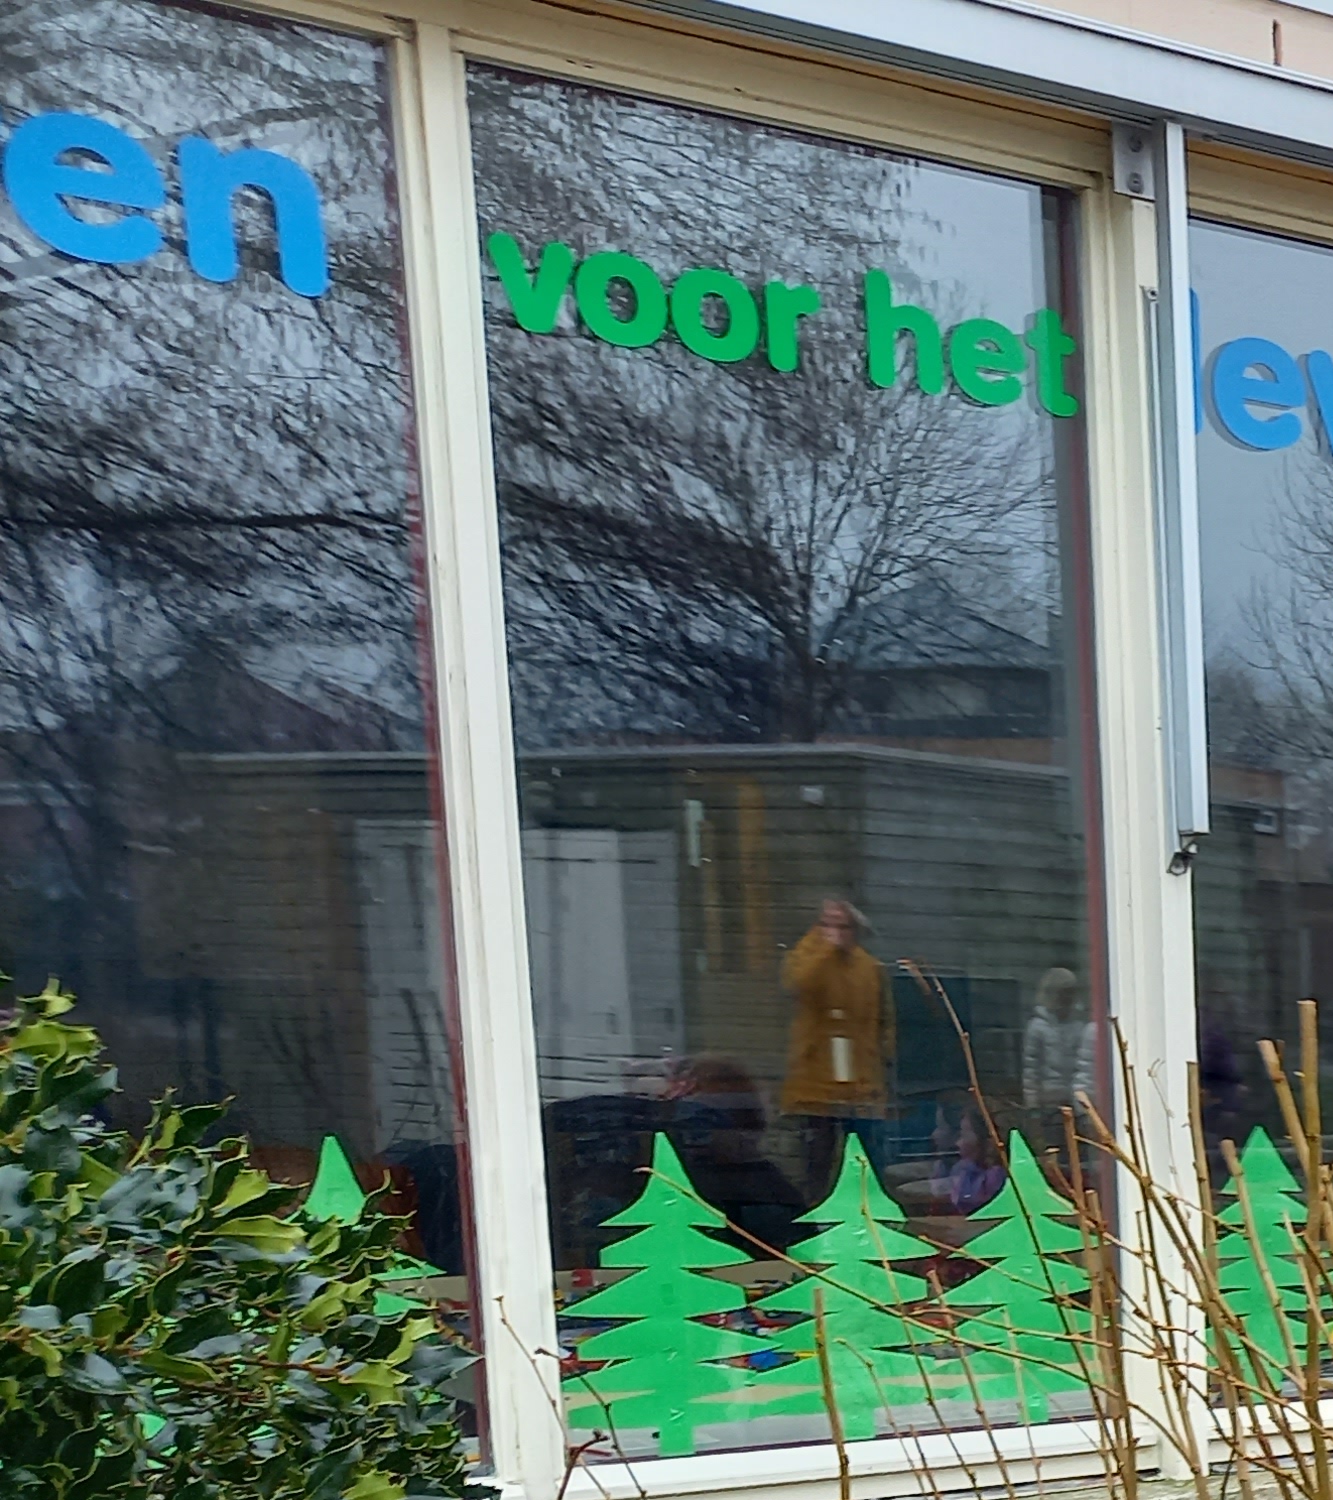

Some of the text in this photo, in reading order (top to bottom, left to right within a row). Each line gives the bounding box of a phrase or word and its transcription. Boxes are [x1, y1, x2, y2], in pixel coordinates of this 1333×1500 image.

[3, 111, 329, 298] en
[487, 231, 820, 372] voor
[865, 267, 1079, 417] het
